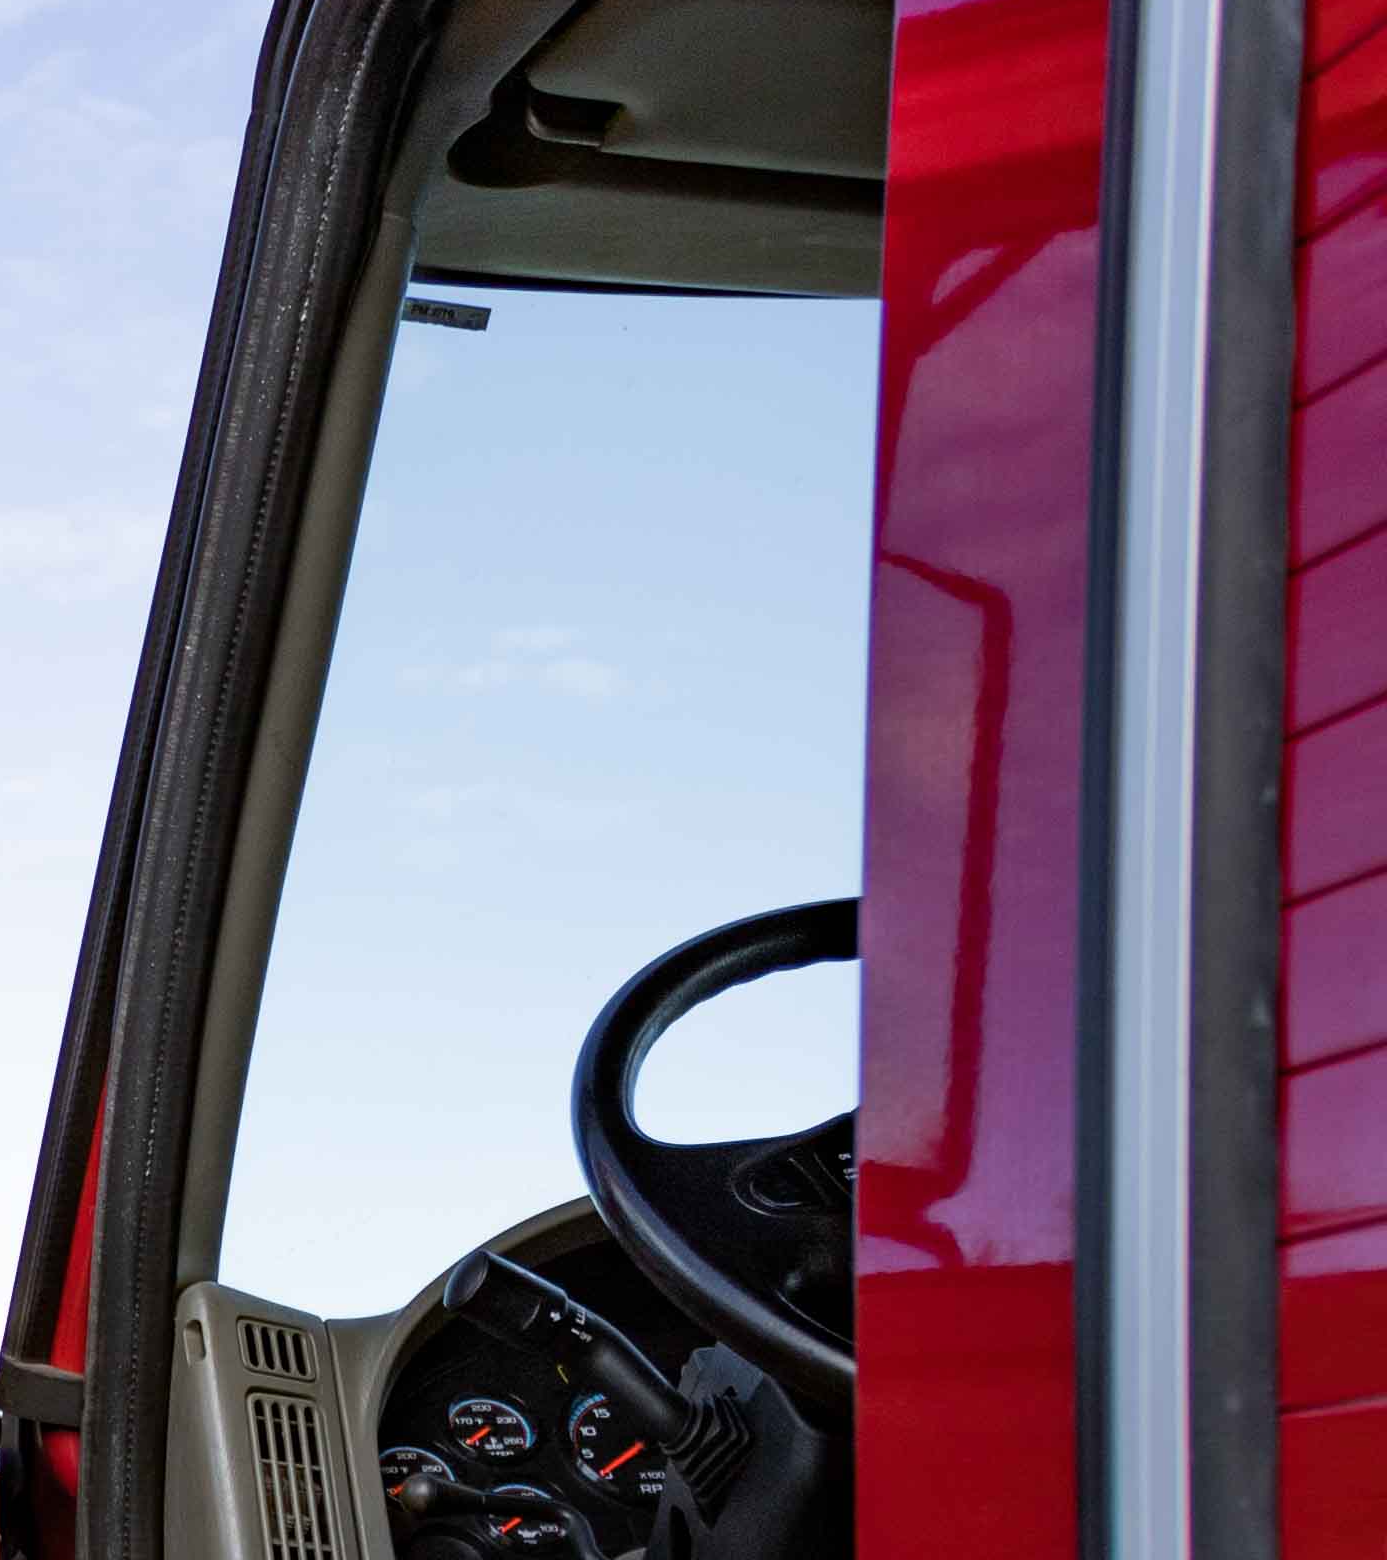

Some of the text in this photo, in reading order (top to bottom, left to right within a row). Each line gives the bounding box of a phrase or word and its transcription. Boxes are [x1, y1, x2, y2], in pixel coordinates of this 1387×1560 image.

[593, 1409, 610, 1418] 15
[579, 1427, 596, 1436] 10
[581, 1449, 594, 1458] 5
[639, 1484, 663, 1493] RP
